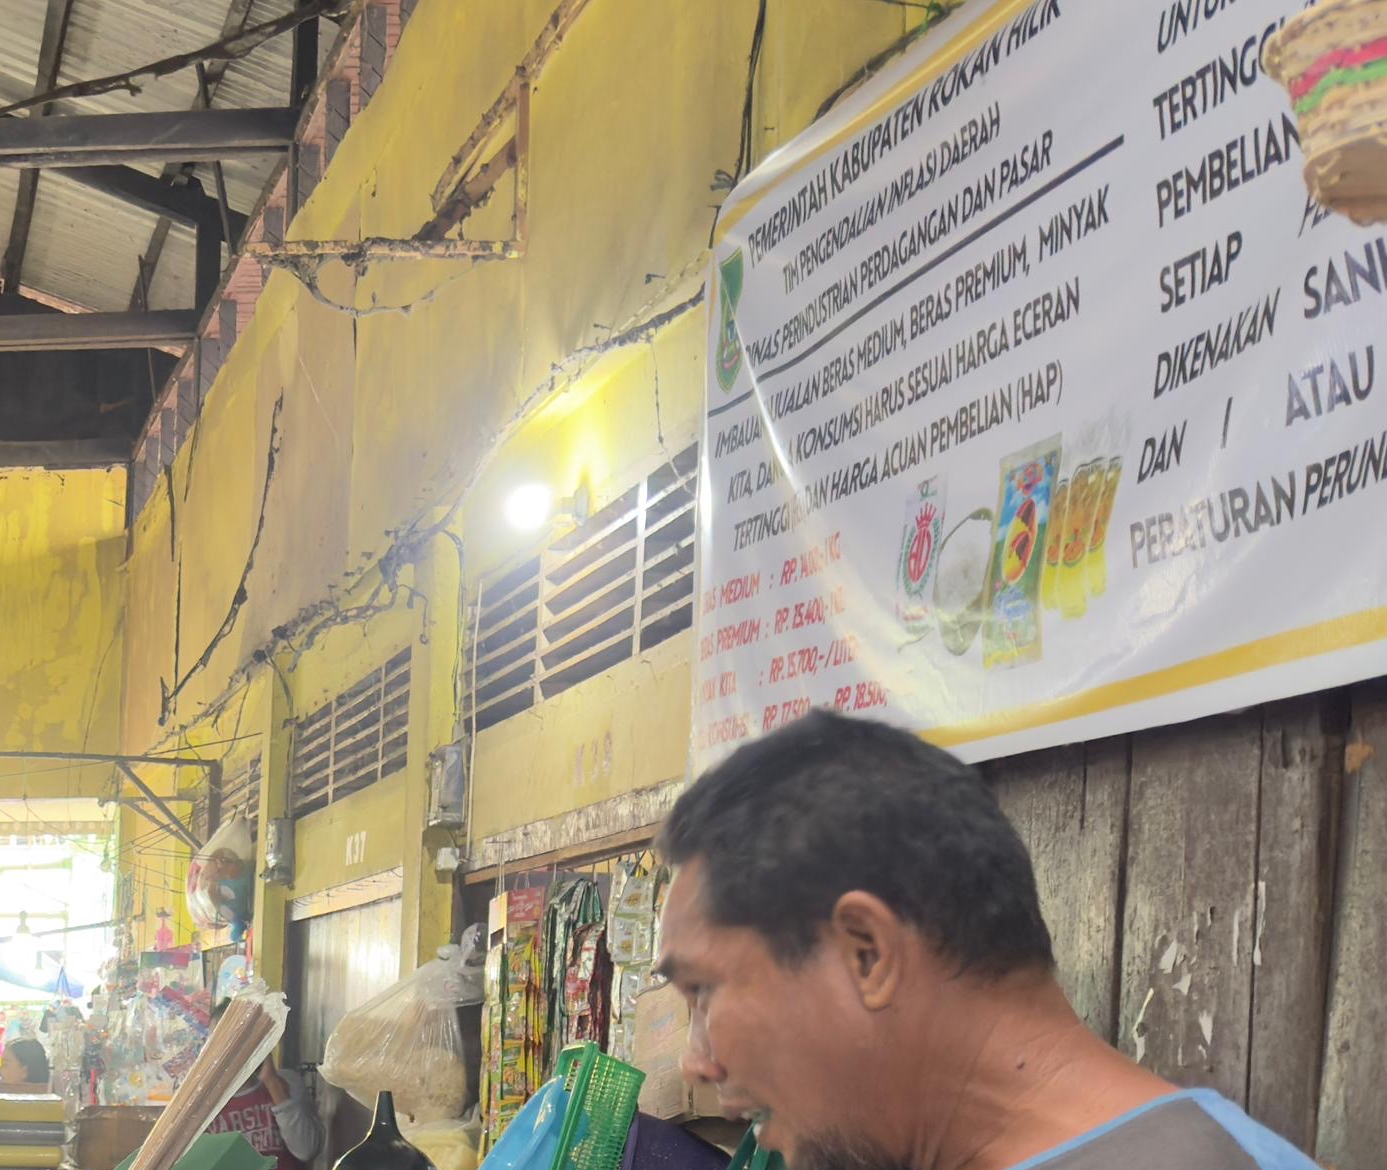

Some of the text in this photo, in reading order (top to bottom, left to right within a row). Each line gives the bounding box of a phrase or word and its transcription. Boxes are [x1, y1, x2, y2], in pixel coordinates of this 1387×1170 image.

[747, 170, 827, 267] PEMERINTAH
[829, 89, 928, 200] KABUPATEN
[927, 25, 1004, 118] ROKAN
[783, 101, 1001, 295] TIM PENGENDALIAN INFLASI DAERAH
[781, 266, 858, 354] PERINDUSTRIAN
[861, 194, 959, 295] PERDAGANGAN
[962, 168, 996, 224] DAN
[999, 129, 1054, 200] PASAR
[821, 349, 856, 399] BERAS
[856, 318, 907, 373] MEDIUM,
[910, 281, 952, 341] BERAS
[955, 235, 1030, 312] PREMIUM,
[1038, 184, 1110, 265] MINYAK
[1159, 230, 1243, 313] SETIAP
[796, 401, 864, 464] KONSUMSI
[864, 376, 906, 434] HARUS
[907, 348, 953, 406] SESUAI
[955, 313, 1012, 382] HARGA
[1013, 275, 1081, 346] ECERAN
[1137, 419, 1187, 485] DAN
[1285, 345, 1375, 427] ATAU
[1153, 287, 1281, 400] DIKENAKAN
[804, 474, 831, 515] DAN
[830, 455, 878, 504] HARGA
[880, 430, 927, 482] ACUAN
[930, 384, 1013, 457] PEMBELIAN
[1016, 359, 1064, 424] (HAP)
[1129, 470, 1296, 568] PERATURAN
